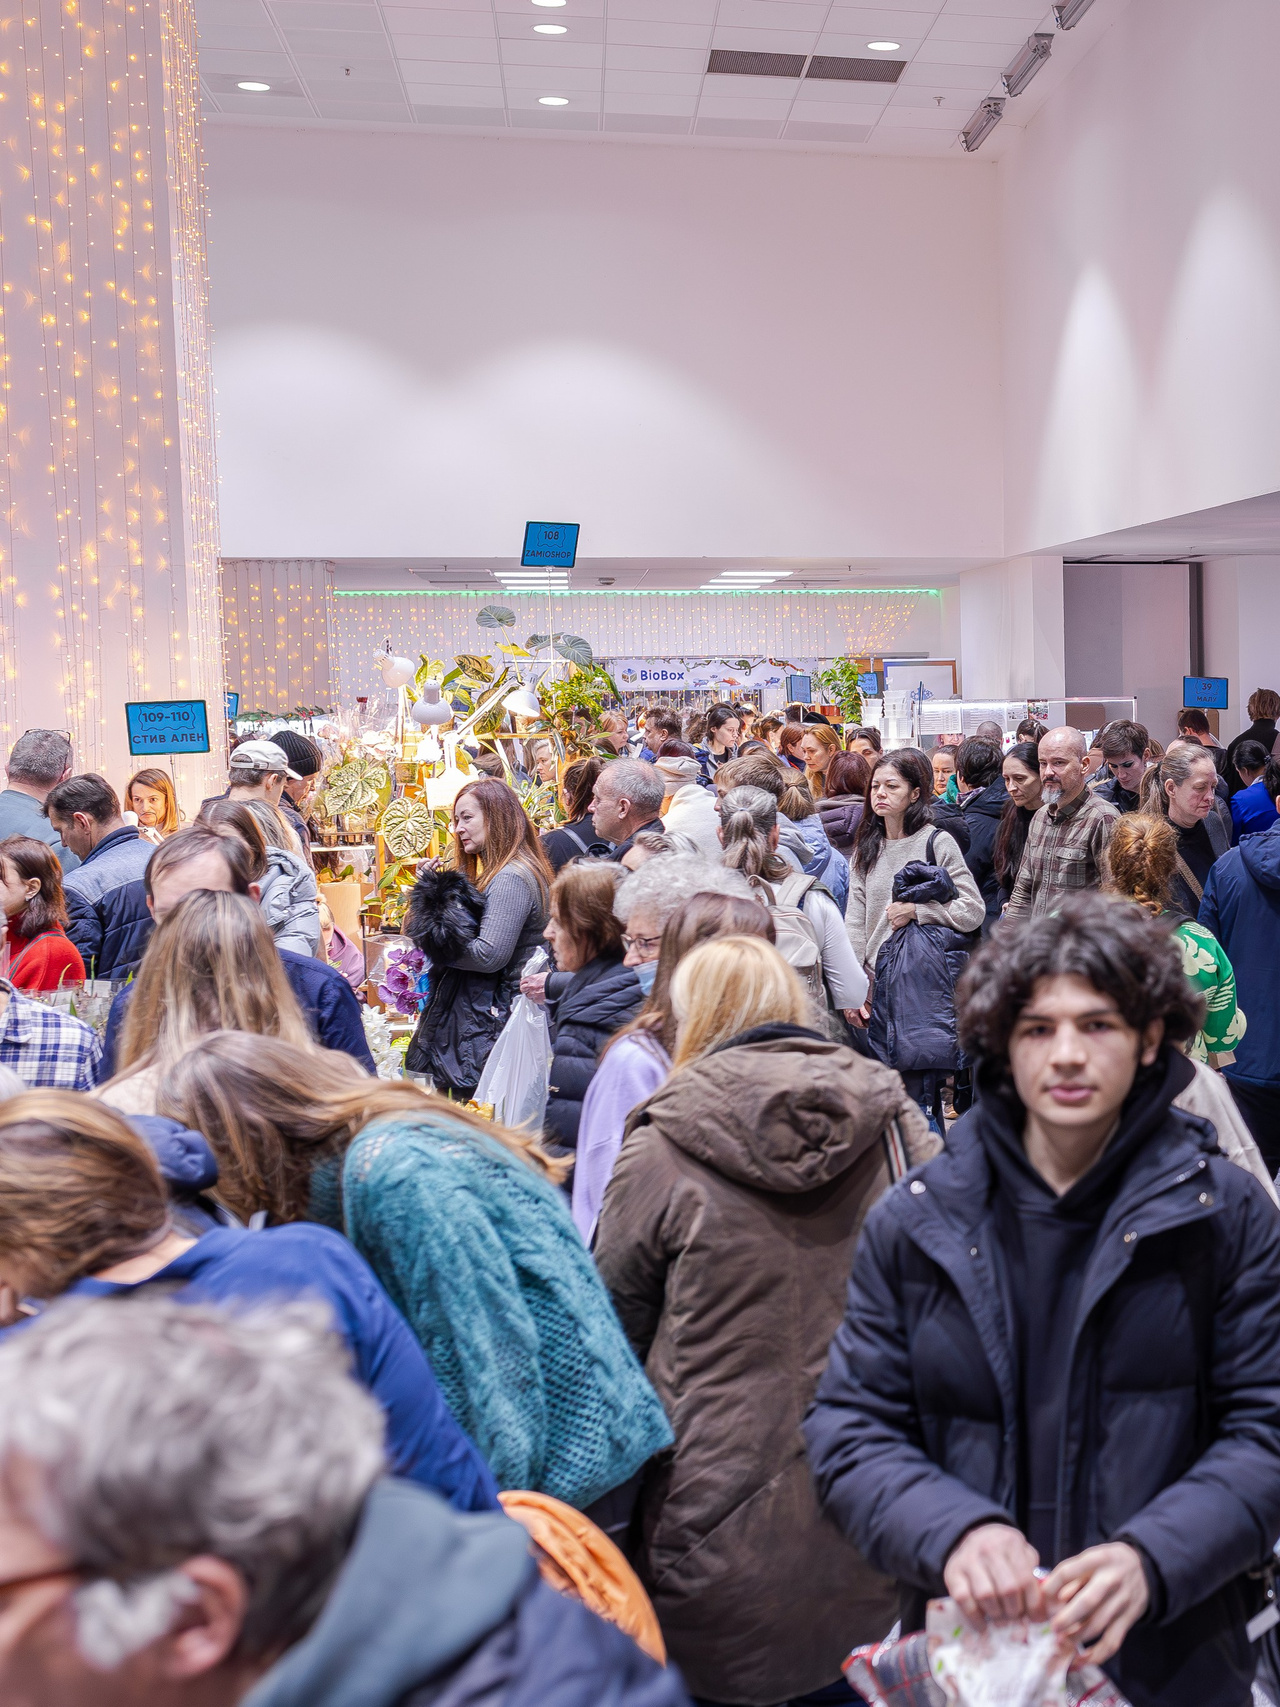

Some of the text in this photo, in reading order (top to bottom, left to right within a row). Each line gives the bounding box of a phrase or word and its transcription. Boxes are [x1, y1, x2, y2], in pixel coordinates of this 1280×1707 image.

[544, 531, 559, 540] 108
[526, 550, 571, 558] ZAMIOSHOP
[641, 670, 684, 680] BioBox
[142, 711, 190, 722] 109-110
[133, 733, 204, 744] СТИВ АЛЕН
